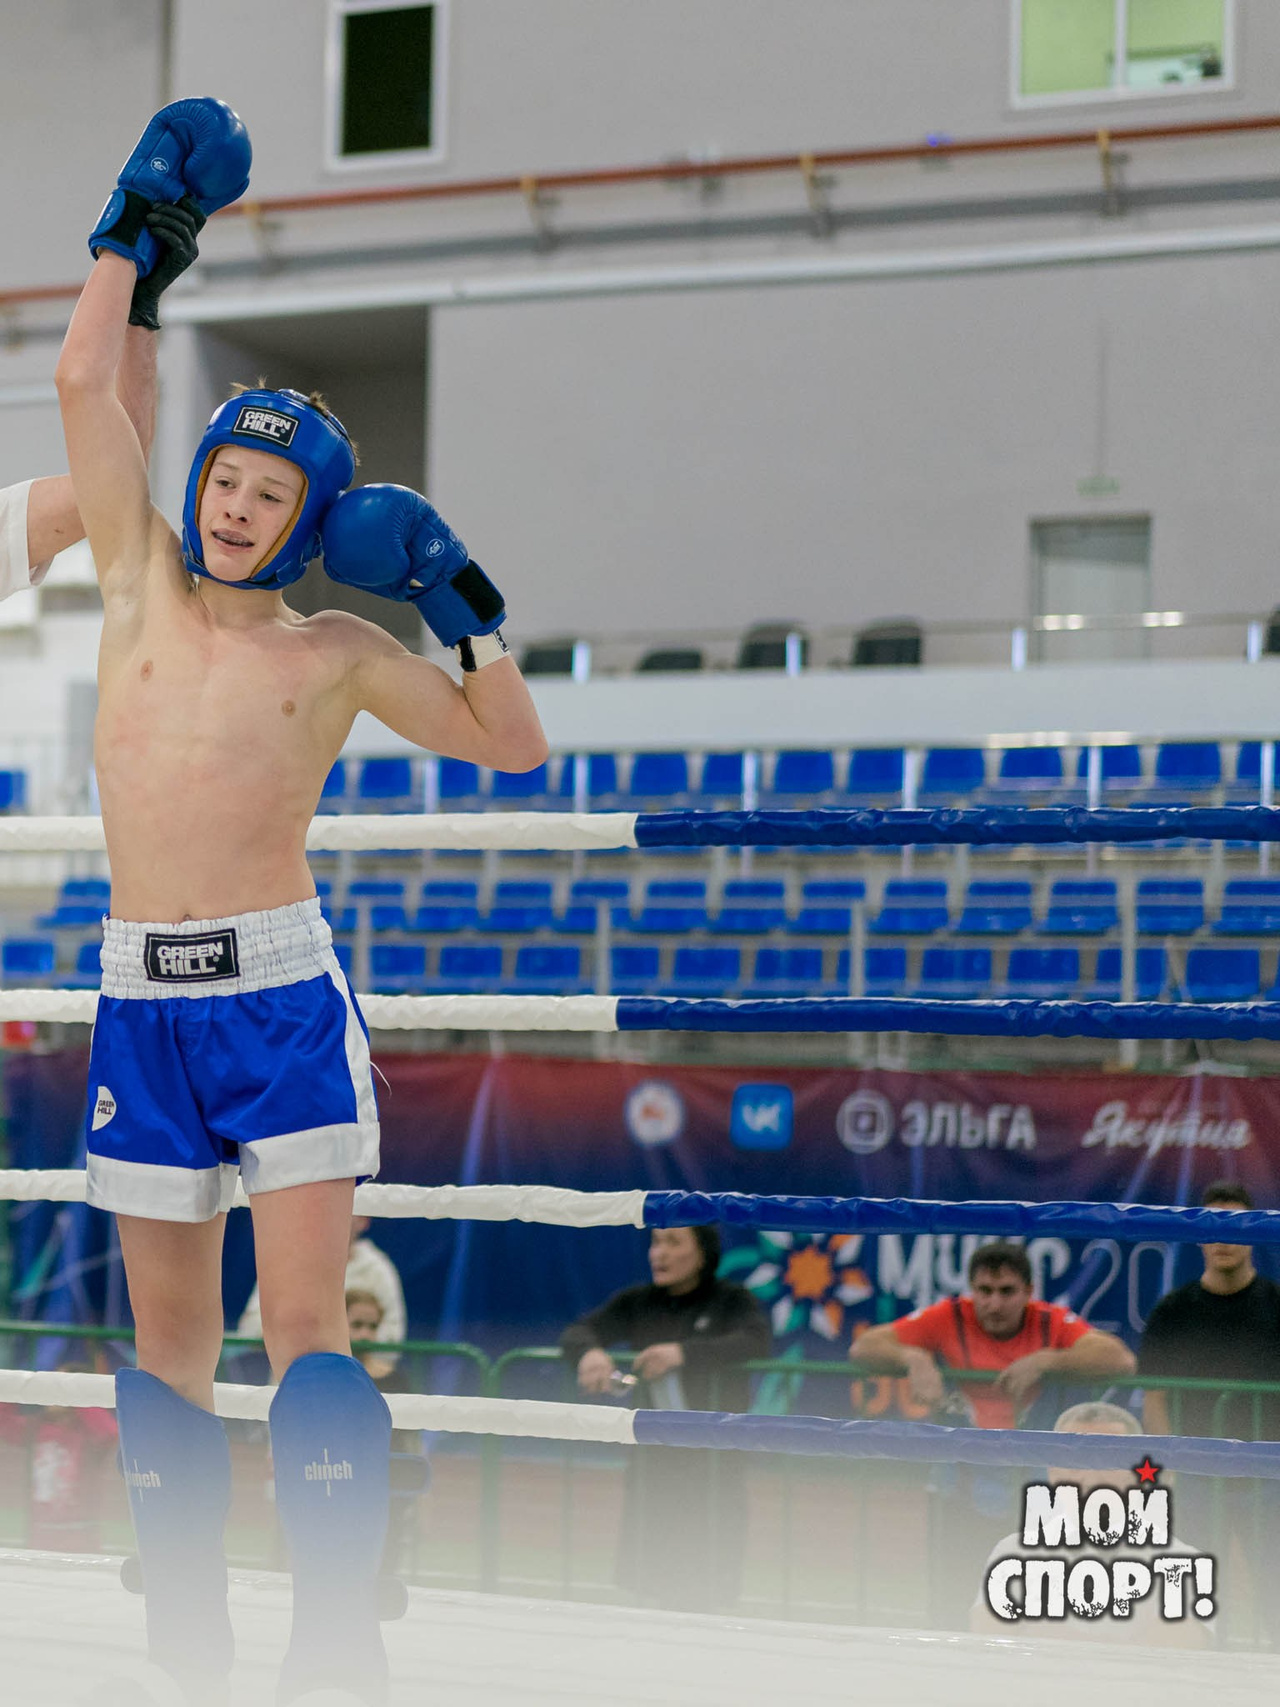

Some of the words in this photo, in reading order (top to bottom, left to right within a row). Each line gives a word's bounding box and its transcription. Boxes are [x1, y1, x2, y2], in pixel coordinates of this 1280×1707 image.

[242, 419, 280, 437] HILL
[245, 411, 291, 430] GREEN
[156, 942, 224, 960] GREEN
[159, 957, 217, 975] HILL
[97, 1107, 112, 1115] HILL
[98, 1099, 115, 1108] GREEN
[901, 1101, 1038, 1149] ЭЛЬГА
[305, 1460, 352, 1481] clinch
